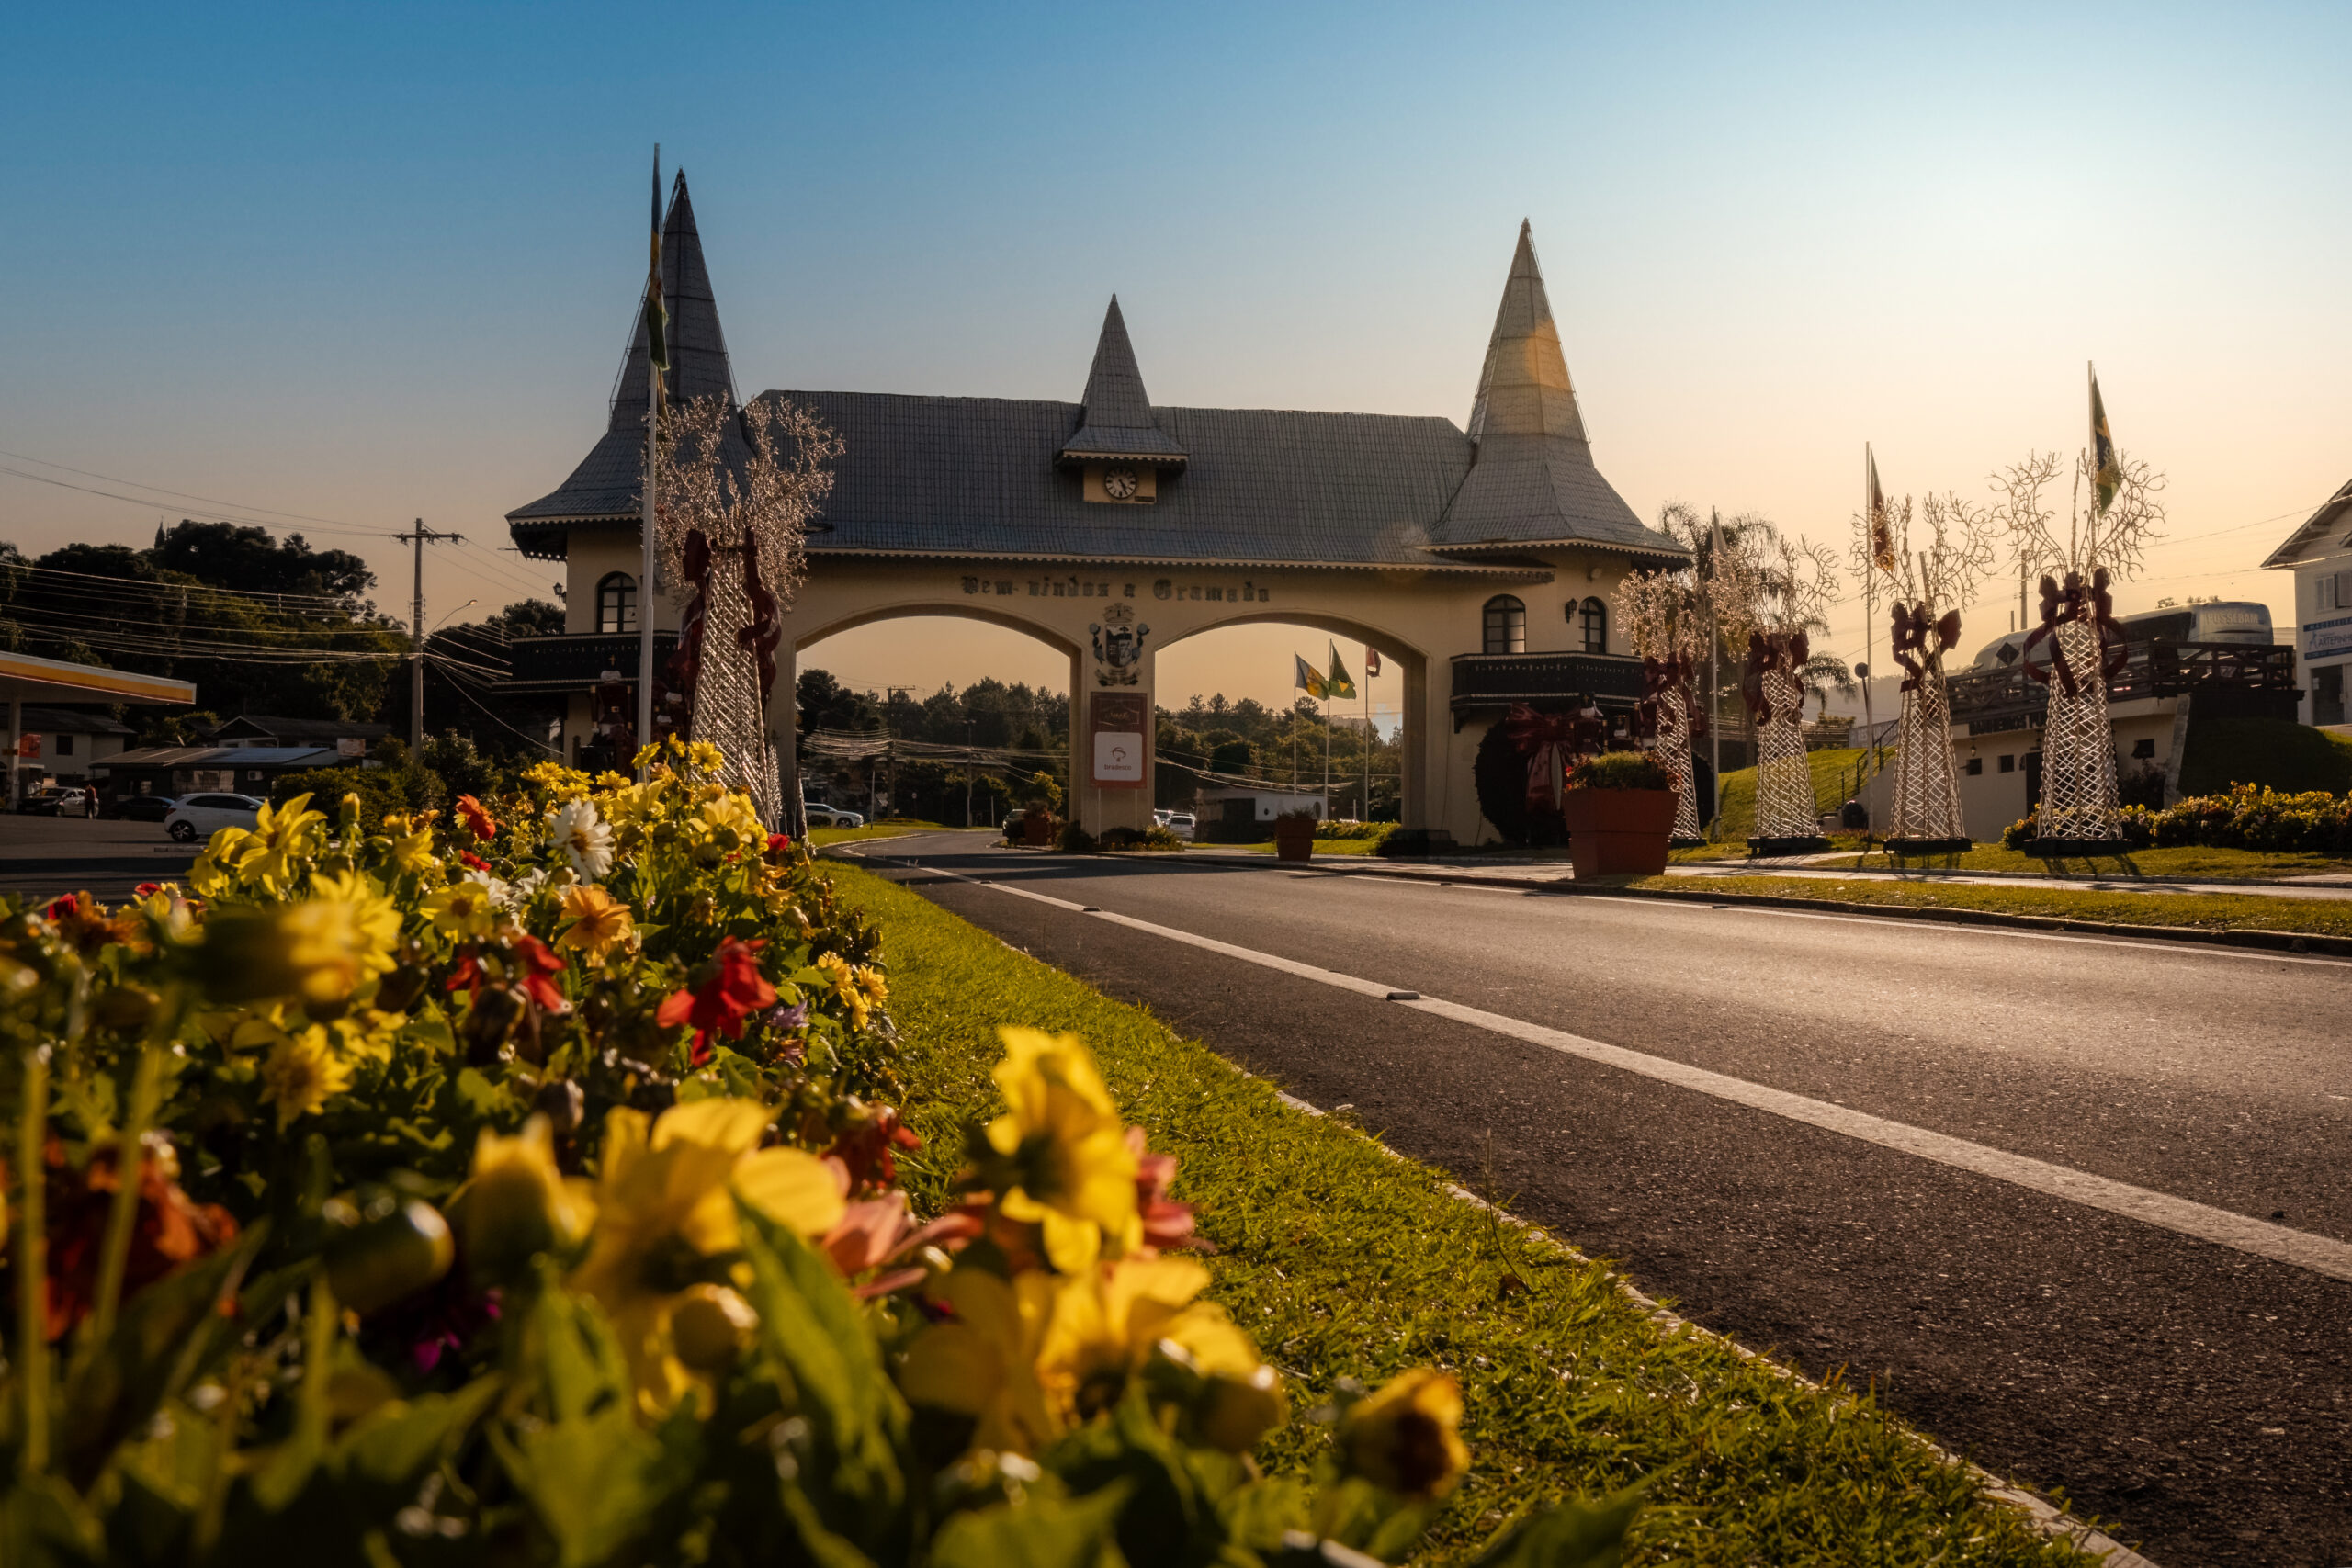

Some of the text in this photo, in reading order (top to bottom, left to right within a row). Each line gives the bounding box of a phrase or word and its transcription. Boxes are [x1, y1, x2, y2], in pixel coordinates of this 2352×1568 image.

[1123, 582, 1136, 599] a
[1153, 578, 1271, 603] Gramado
[1103, 763, 1132, 772] bradesco
